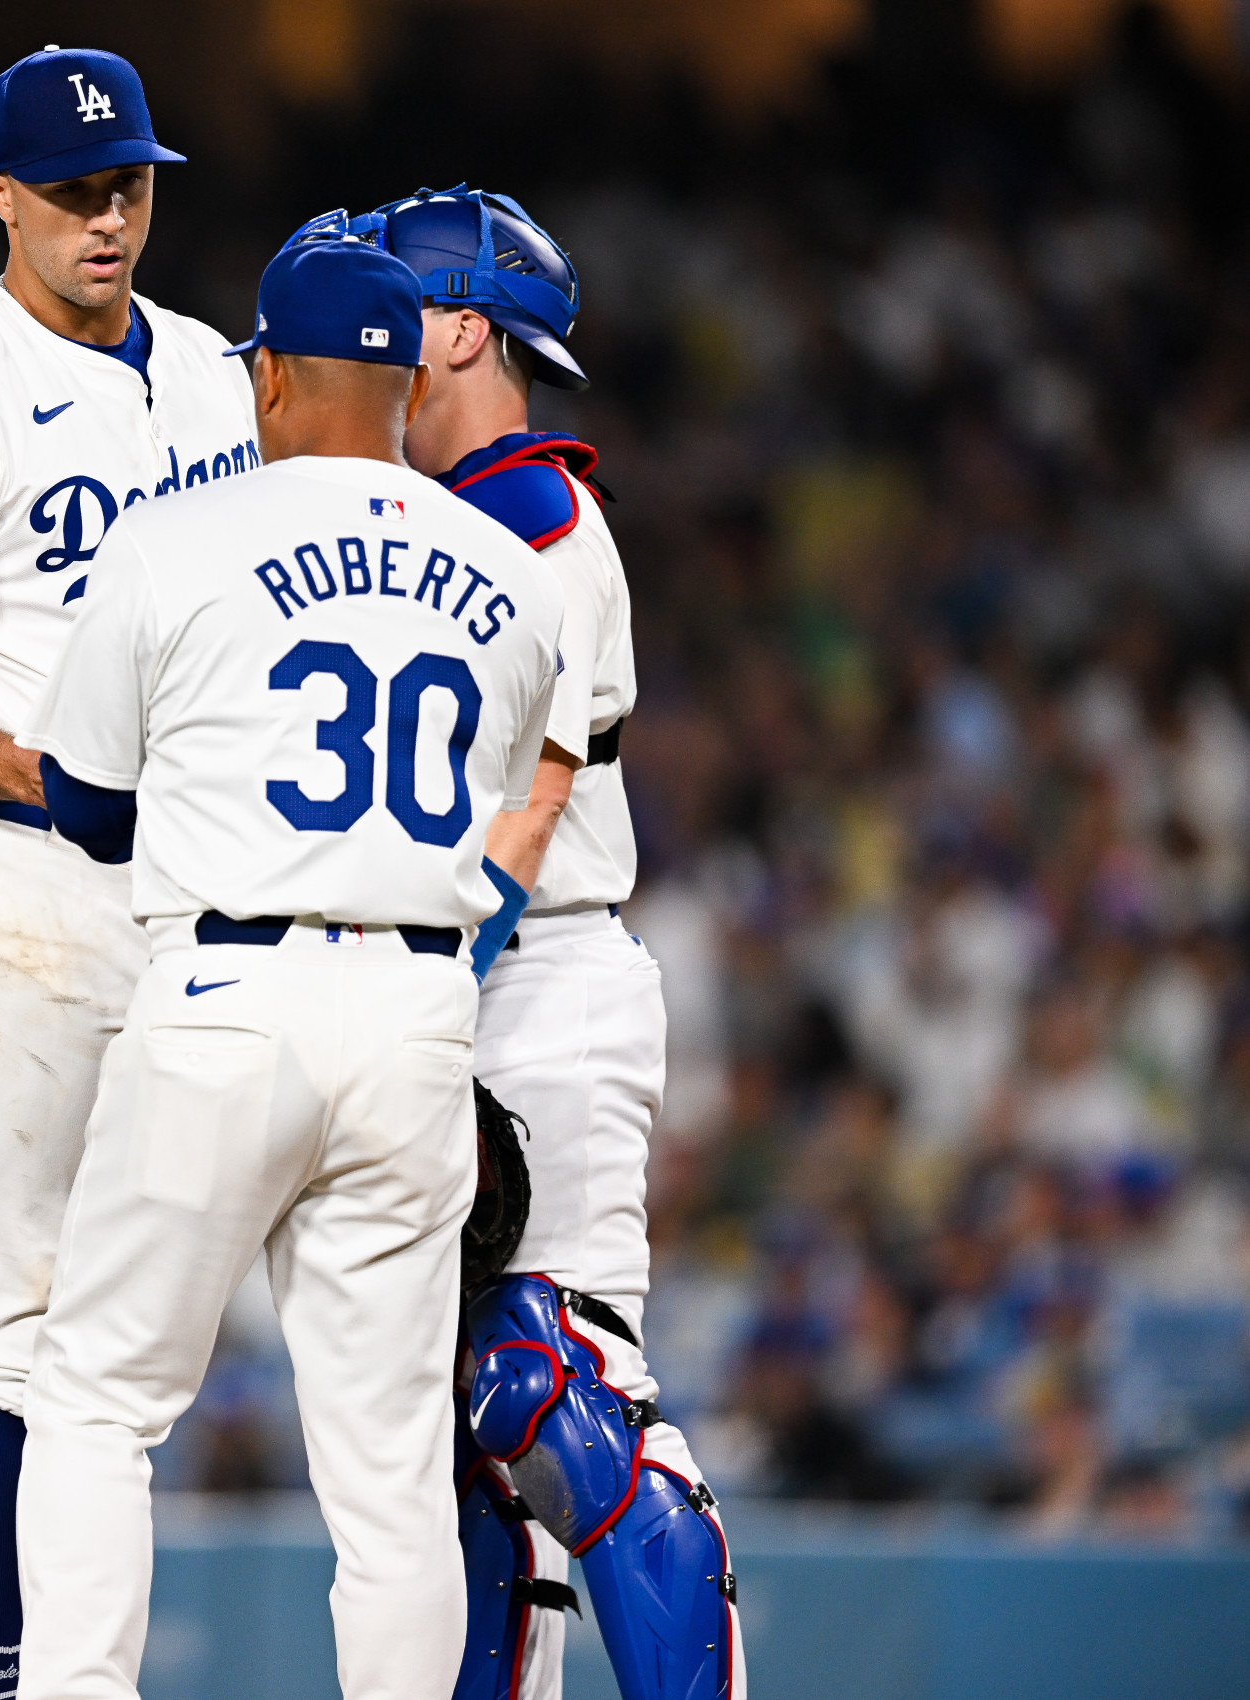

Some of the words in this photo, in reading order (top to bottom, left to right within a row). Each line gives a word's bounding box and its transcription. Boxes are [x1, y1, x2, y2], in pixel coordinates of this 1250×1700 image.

[67, 73, 116, 123] LA
[253, 537, 516, 646] ROBERTS
[265, 639, 483, 849] 30
